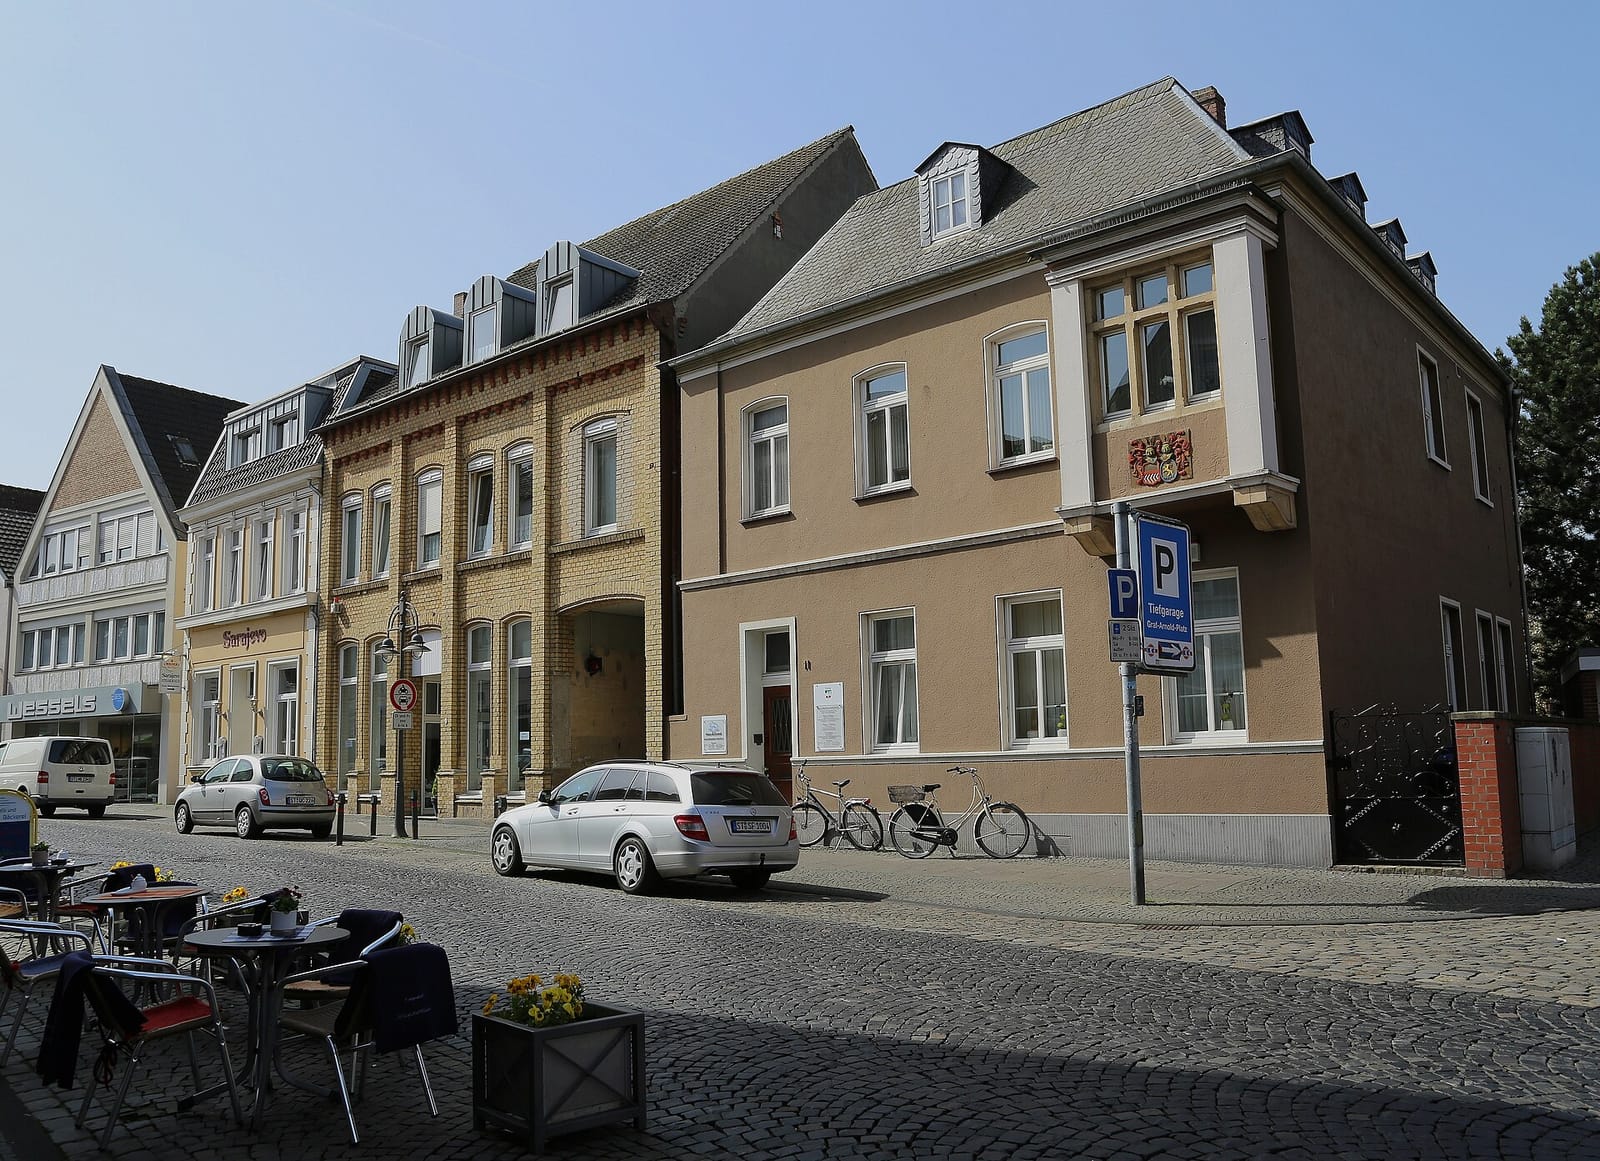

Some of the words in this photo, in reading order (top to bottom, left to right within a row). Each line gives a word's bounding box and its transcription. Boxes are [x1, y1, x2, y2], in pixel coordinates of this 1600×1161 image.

[1155, 544, 1175, 590] P
[1116, 575, 1134, 613] P
[1148, 602, 1184, 620] Tiefgarage
[1146, 620, 1188, 633] Graf-Arnold-Platz
[222, 627, 267, 651] Sarajevo
